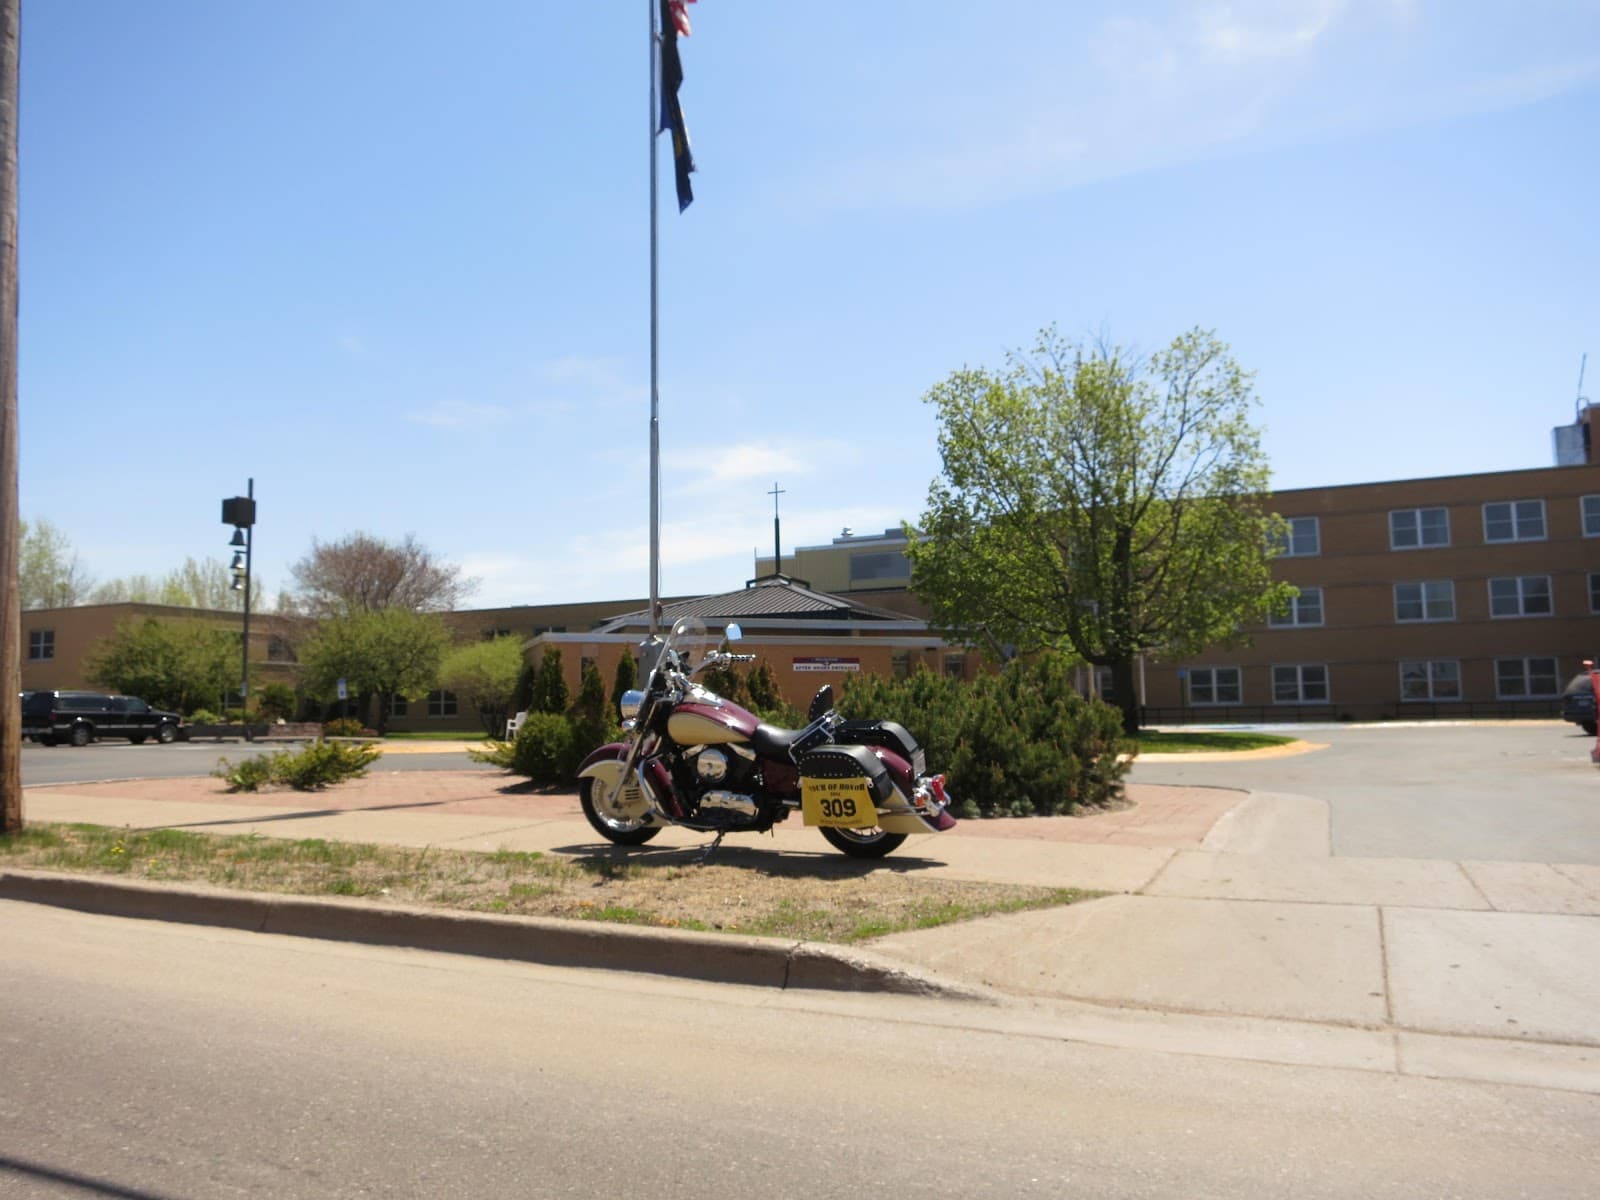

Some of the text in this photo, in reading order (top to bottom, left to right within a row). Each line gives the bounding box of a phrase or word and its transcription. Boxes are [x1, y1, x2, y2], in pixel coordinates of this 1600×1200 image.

[828, 783, 838, 791] OF
[839, 783, 865, 791] HONOR
[820, 799, 857, 818] 309
